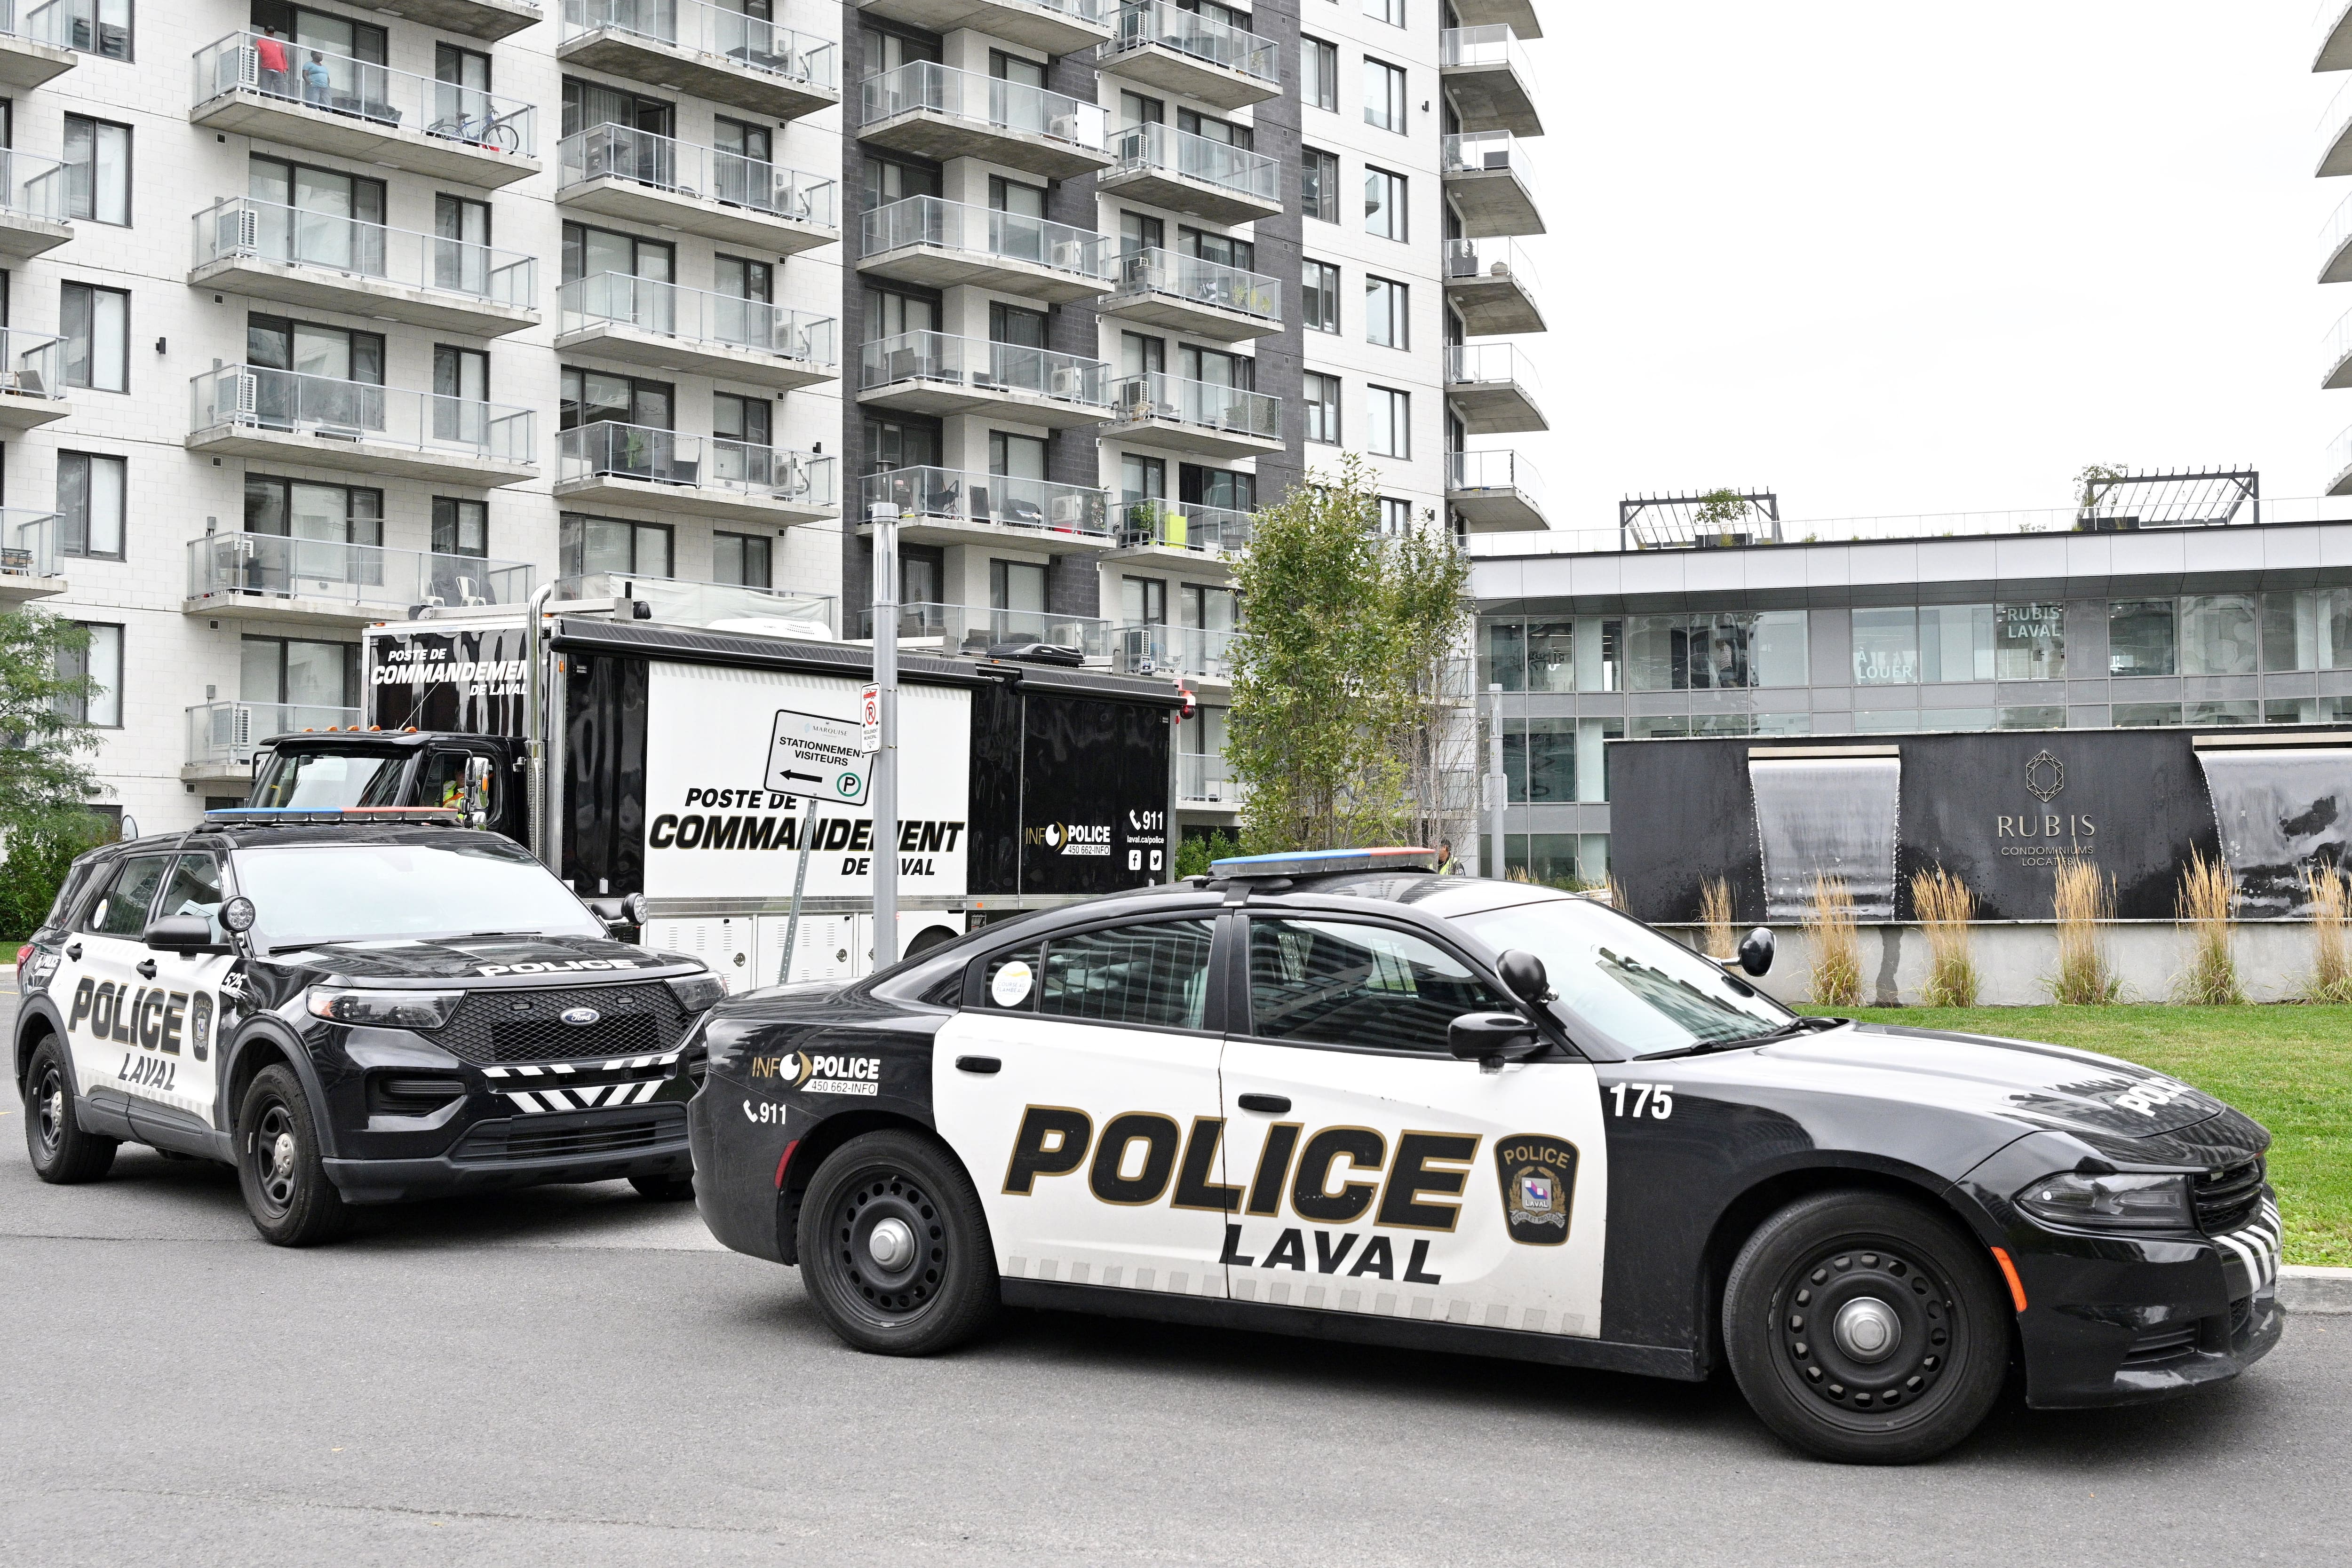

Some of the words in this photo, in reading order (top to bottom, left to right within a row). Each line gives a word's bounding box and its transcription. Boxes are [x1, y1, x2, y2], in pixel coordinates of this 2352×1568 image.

[2008, 607, 2060, 620] RUBIS
[2008, 624, 2060, 638] LAVAL
[388, 649, 428, 662] POSTE
[429, 648, 447, 660] DE
[371, 659, 548, 685] COMMANDEMEN
[1859, 665, 1912, 679] LOUER
[470, 684, 487, 696] DE
[489, 683, 527, 695] LAVAL
[812, 725, 848, 736] MARQUISE
[795, 750, 848, 766] VISITEURS
[843, 776, 856, 792] P
[685, 788, 763, 808] POSTE
[768, 793, 797, 809] DE
[1143, 811, 1163, 830] 911
[1998, 815, 2095, 837] RUBIS
[649, 814, 965, 852] COMMANDEENT
[1068, 825, 1110, 842] POLICE
[1127, 835, 1164, 845] laval.ca/police
[1068, 846, 1079, 854] 450
[2001, 846, 2093, 855] CONDOMINIUMS
[841, 858, 870, 875] DE
[897, 858, 935, 875] VAL
[476, 959, 640, 977] POLICE
[220, 972, 248, 994] 525
[195, 998, 212, 1013] POLICE
[67, 975, 189, 1056] POLICE
[571, 1011, 592, 1022] Ford
[118, 1053, 175, 1091] LAVAL
[812, 1055, 881, 1080] POLICE
[812, 1081, 828, 1091] 450
[831, 1082, 876, 1094] 662-INFO
[1610, 1083, 1673, 1119] 175
[760, 1102, 786, 1125] 911
[1503, 1146, 1570, 1169] POLICE
[1001, 1103, 1483, 1233] POLICE
[1526, 1199, 1549, 1208] LAVAL
[1218, 1224, 1442, 1285] LAVAL
